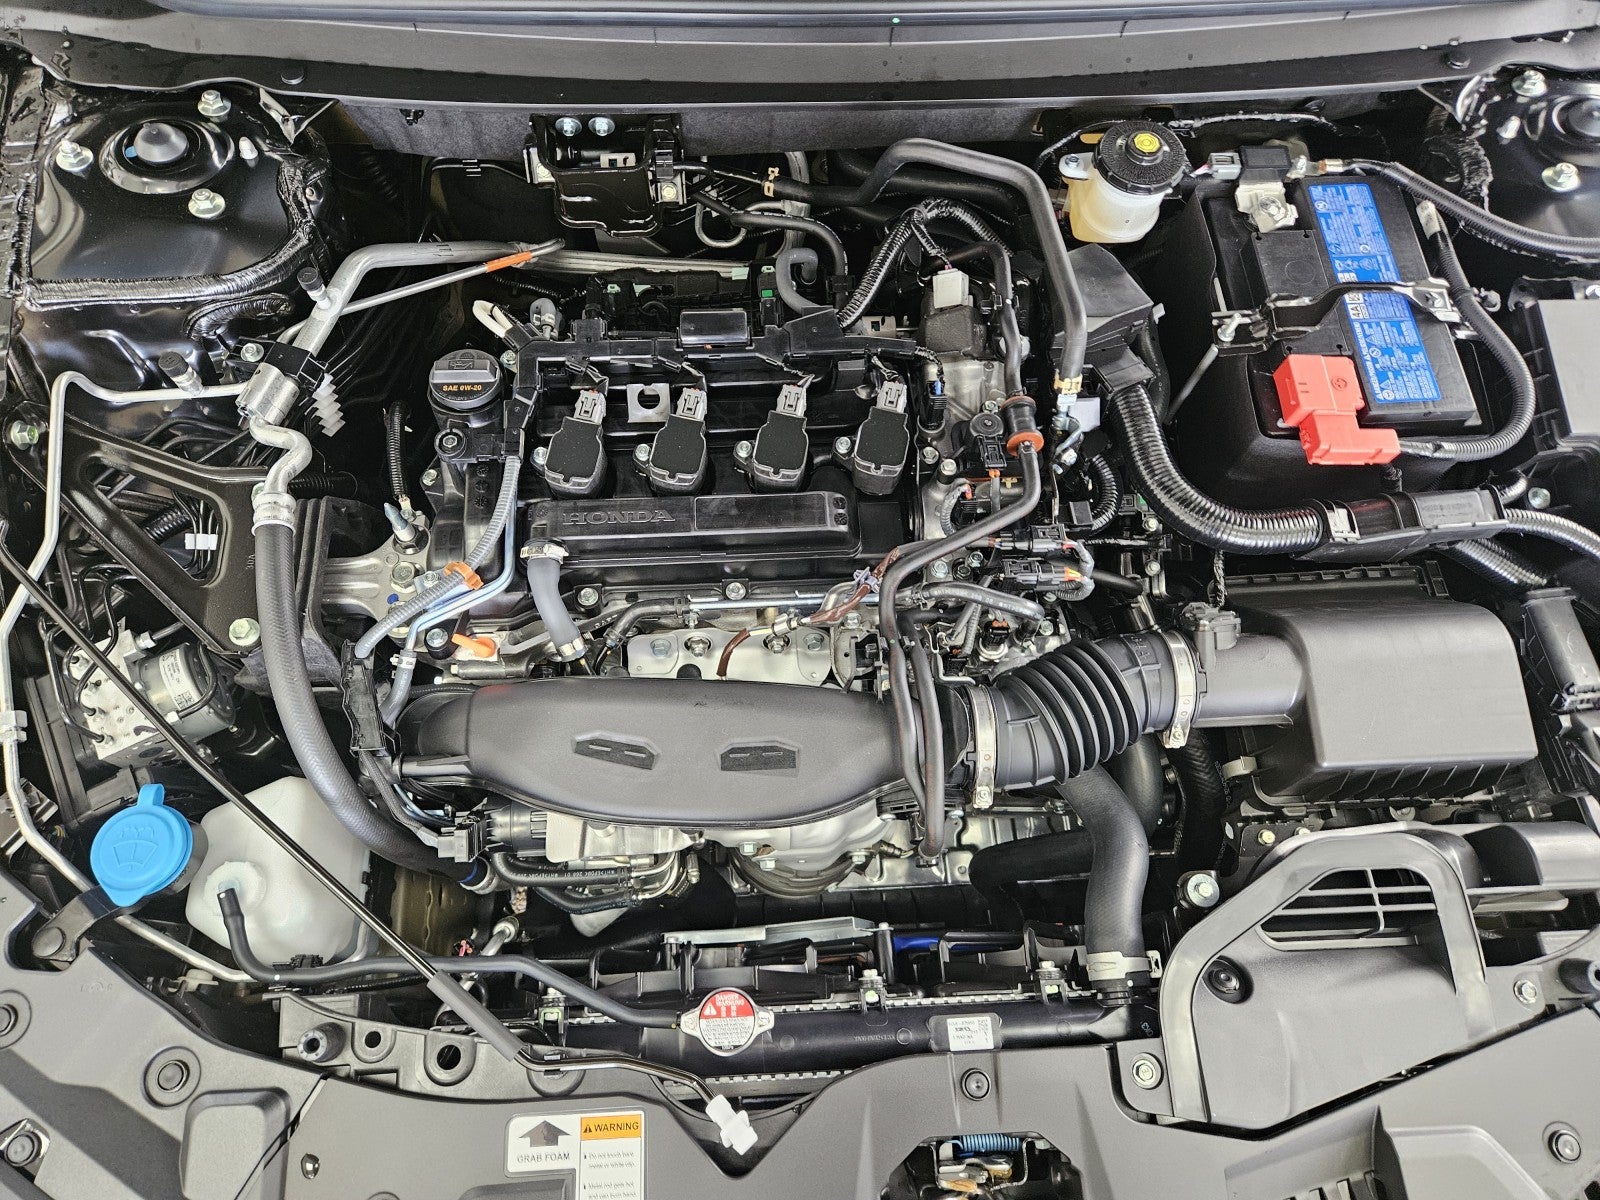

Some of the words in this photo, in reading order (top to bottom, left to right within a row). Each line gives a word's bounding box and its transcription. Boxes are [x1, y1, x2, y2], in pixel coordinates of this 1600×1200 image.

[562, 509, 676, 525] HONDA
[593, 1121, 640, 1132] WARNING
[517, 1155, 542, 1163] GRAB
[544, 1152, 570, 1161] FOAM
